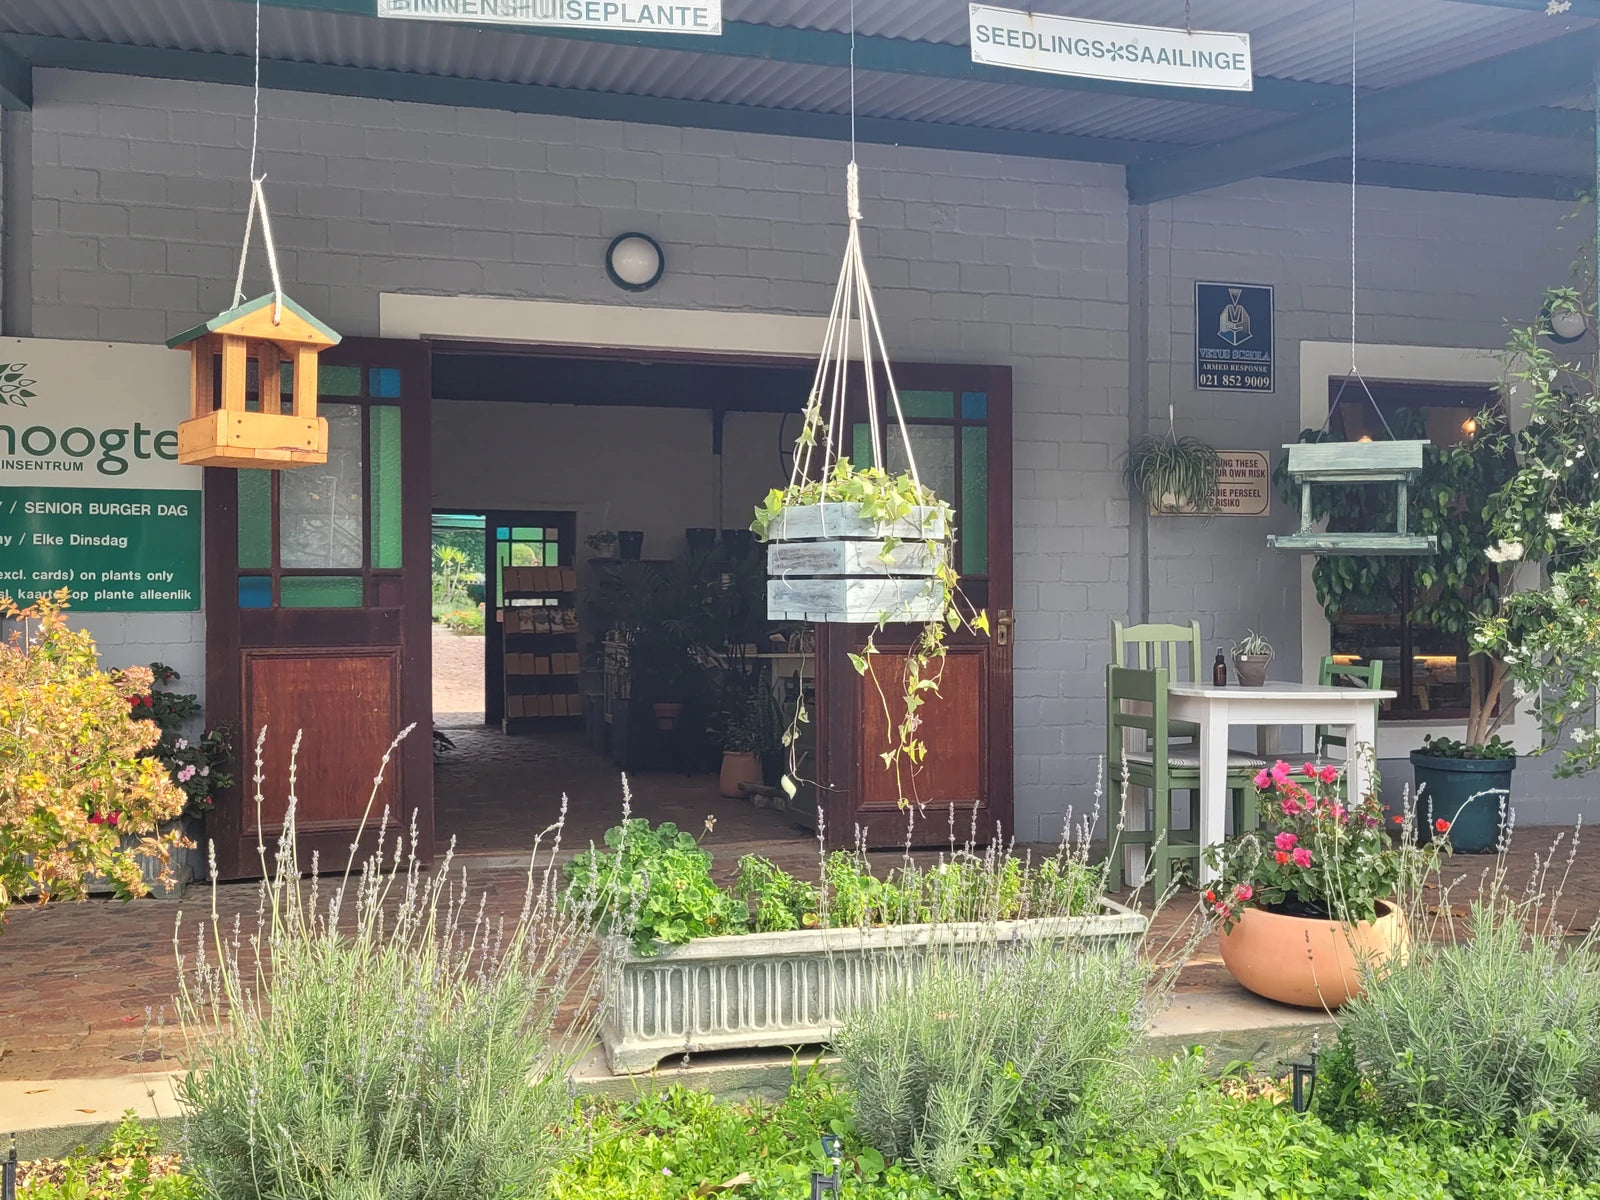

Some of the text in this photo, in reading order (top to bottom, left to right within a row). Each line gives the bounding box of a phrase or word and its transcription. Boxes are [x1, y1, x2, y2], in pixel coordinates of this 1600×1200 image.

[976, 24, 1246, 71] SEEDLINGS SAAILINGE
[1199, 348, 1271, 361] VETUS SCHOLA
[1202, 363, 1268, 373] ARMED RESPONSE
[1200, 374, 1270, 388] 021 852 9009
[1235, 459, 1258, 468] THESE
[1229, 469, 1246, 478] OWN
[1248, 469, 1266, 478] RISK
[1229, 488, 1261, 498] PERSEEL
[24, 501, 82, 514] SENIOR
[89, 503, 151, 516] BURGER
[157, 504, 188, 516] DAG
[33, 533, 64, 545] Elke
[70, 534, 128, 549] Dinsdag
[32, 568, 75, 581] cards)
[80, 571, 96, 580] on
[102, 570, 141, 582] plants
[147, 570, 173, 583] only
[72, 591, 89, 601] op
[94, 589, 134, 601] plante
[140, 588, 192, 600] alleenlik
